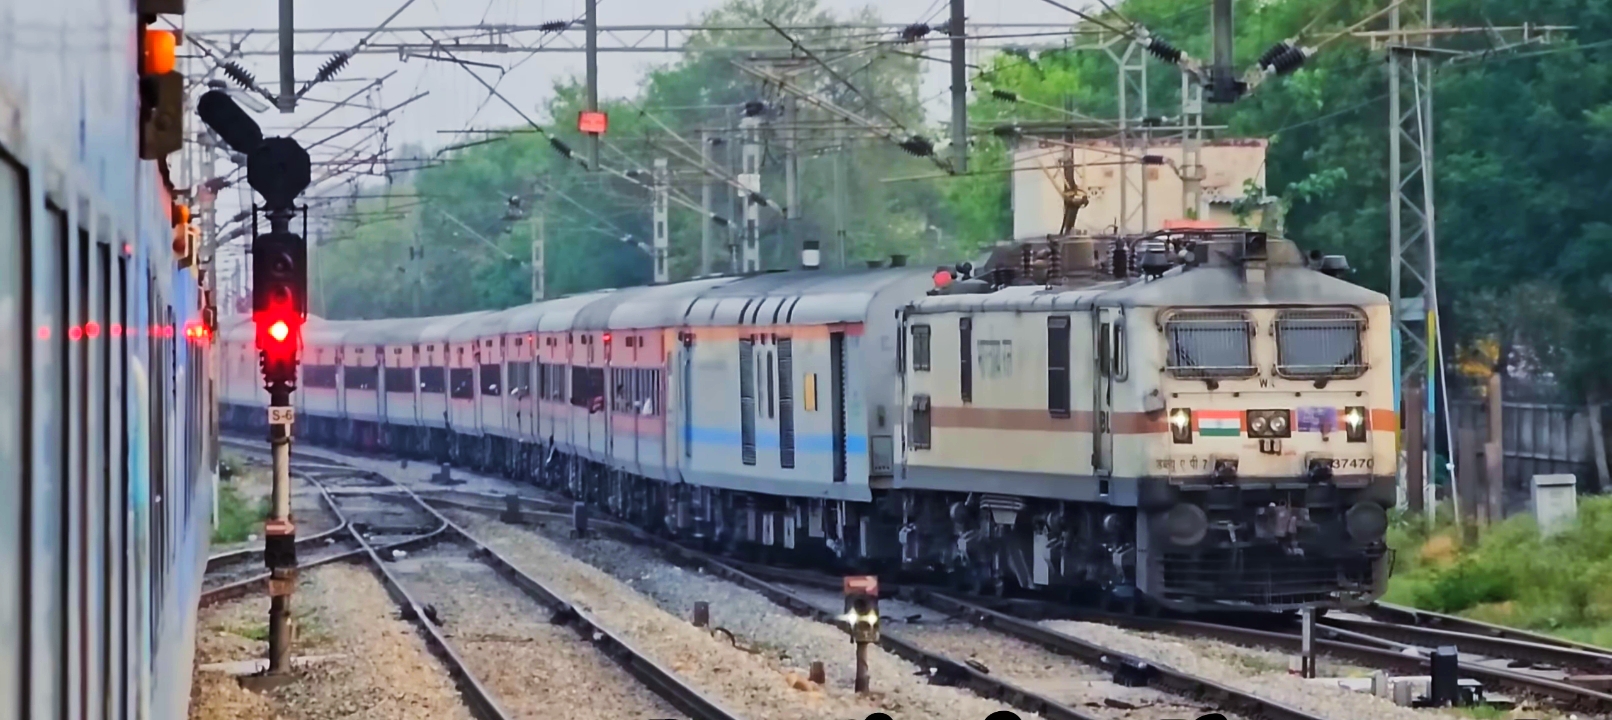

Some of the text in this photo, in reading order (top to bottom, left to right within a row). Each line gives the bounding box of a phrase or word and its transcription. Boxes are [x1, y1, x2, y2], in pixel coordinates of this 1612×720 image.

[272, 409, 293, 421] S-6
[1203, 458, 1208, 470] 7
[1332, 458, 1374, 469] 37470
